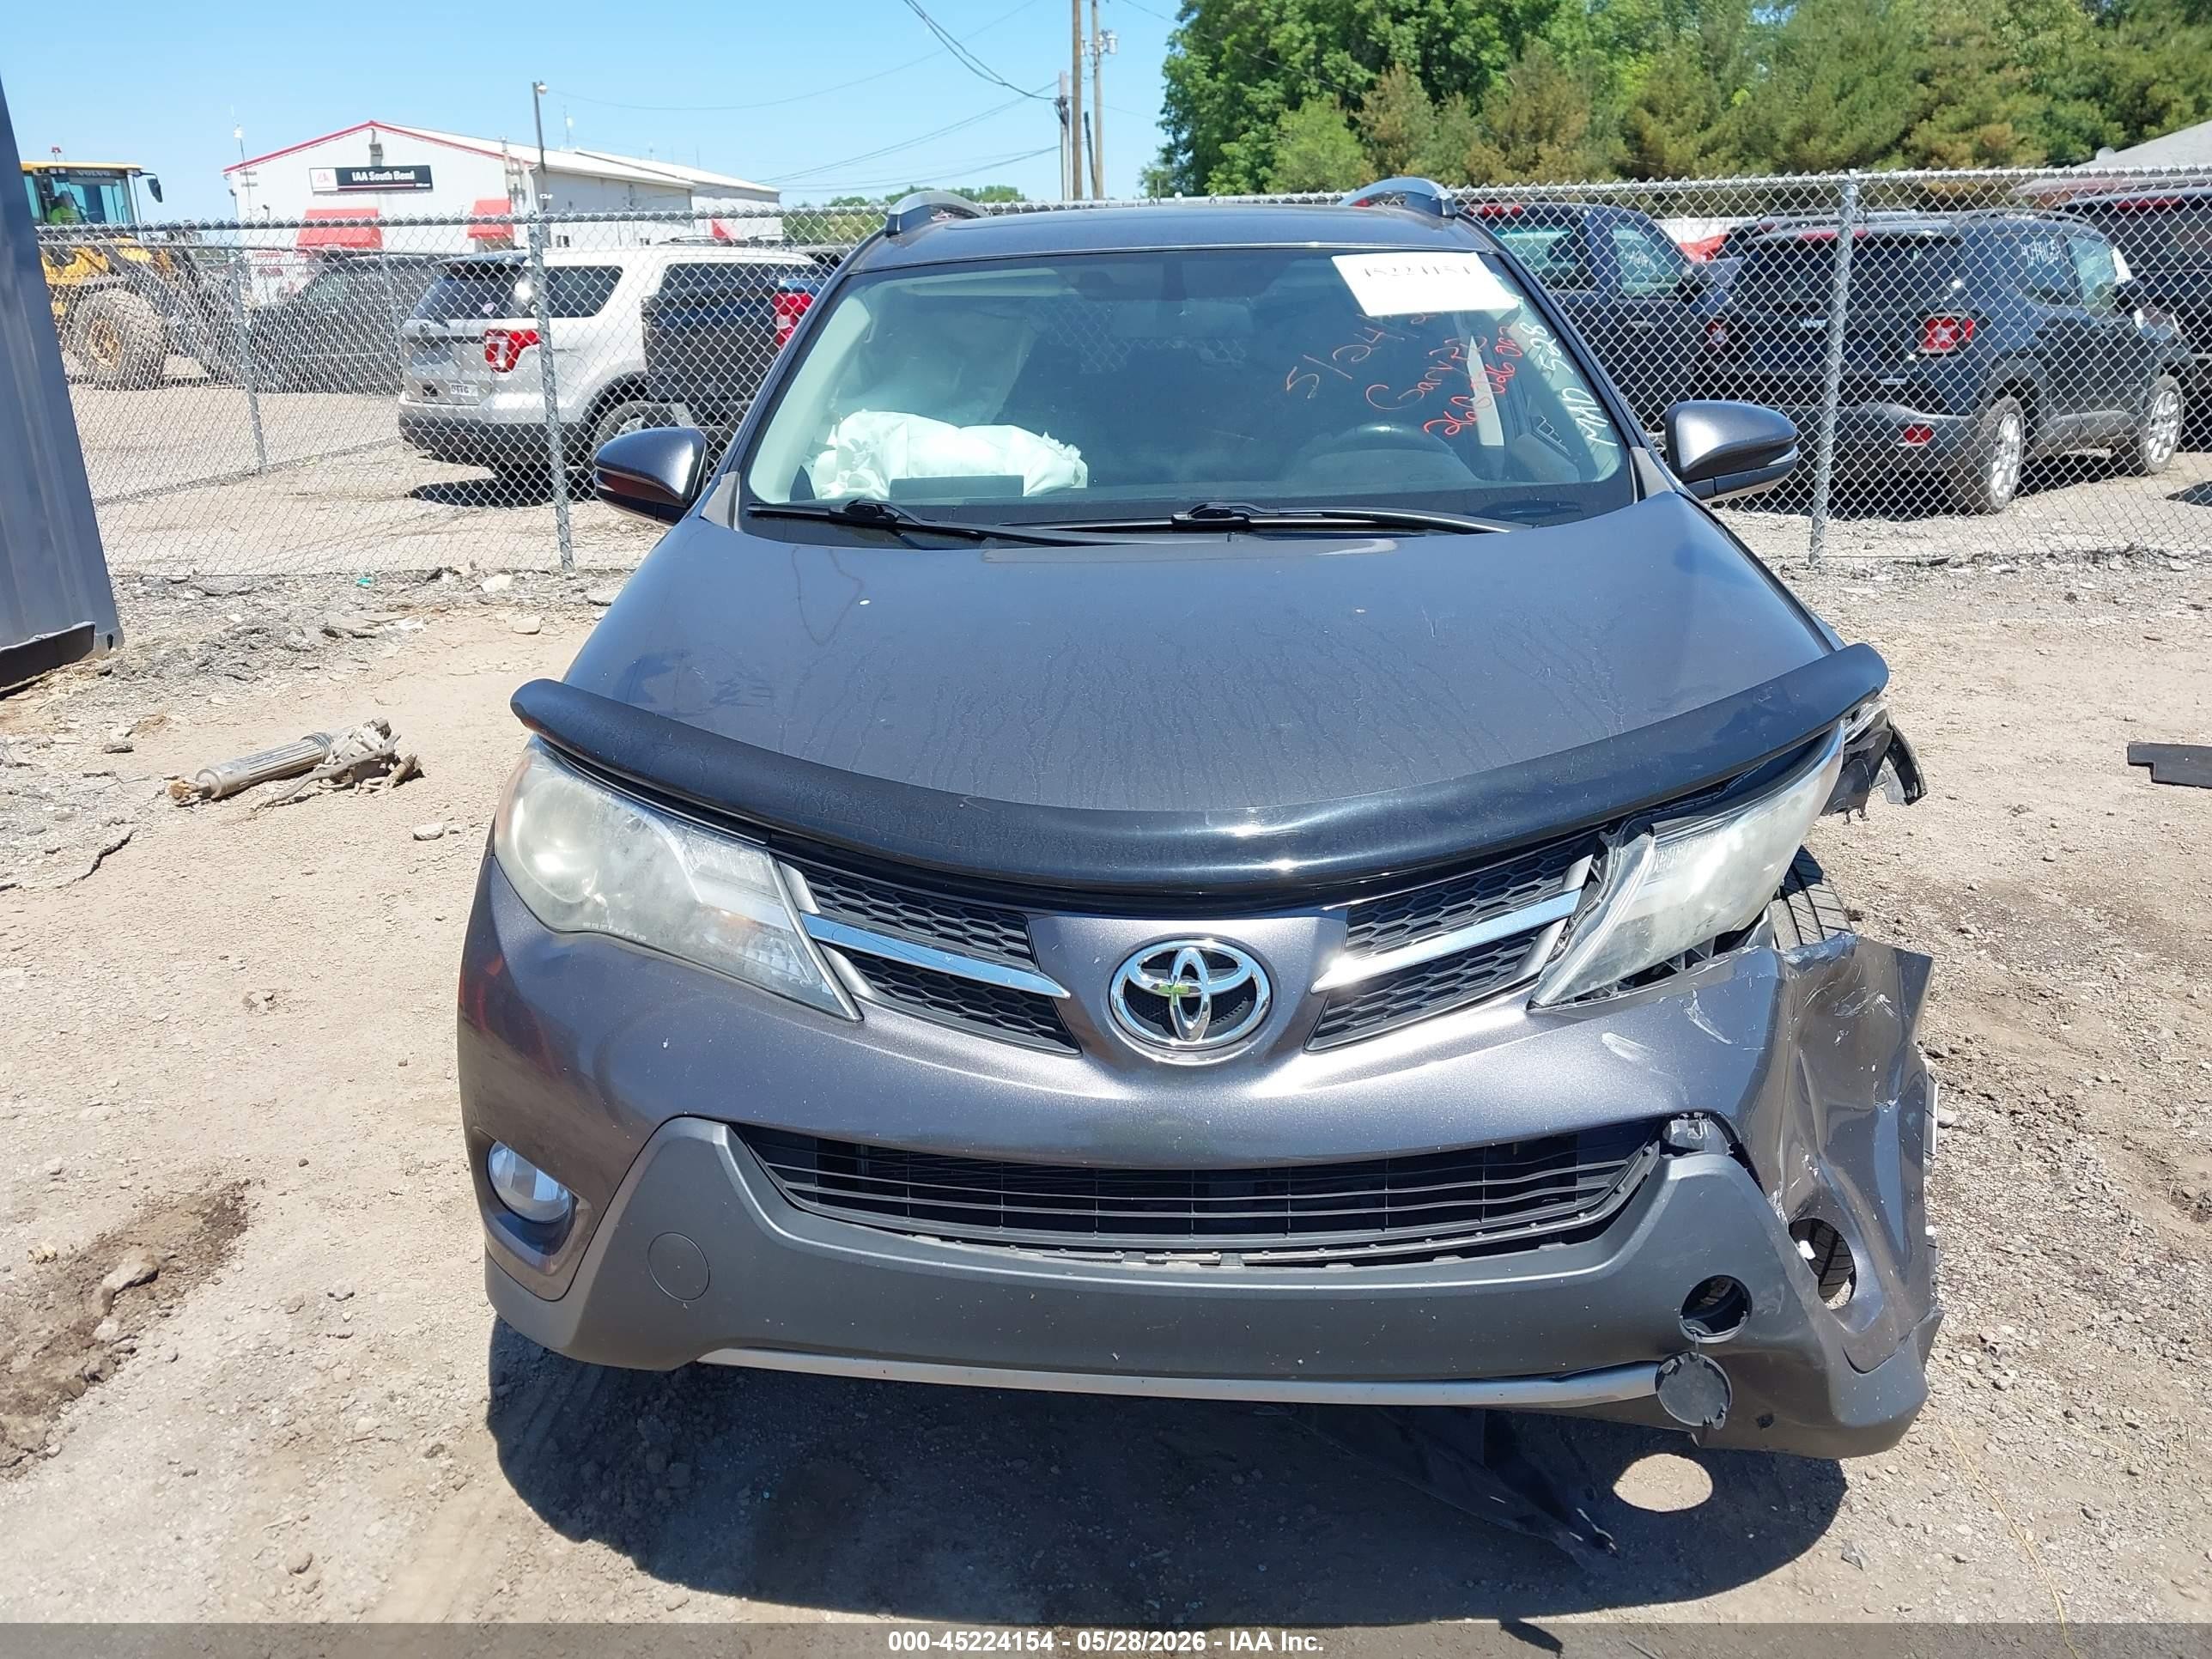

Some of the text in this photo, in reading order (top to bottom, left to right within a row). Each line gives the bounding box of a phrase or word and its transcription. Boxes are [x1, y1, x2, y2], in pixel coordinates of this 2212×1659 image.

[351, 169, 415, 182] IAA South Bend
[1518, 322, 1574, 375] 528
